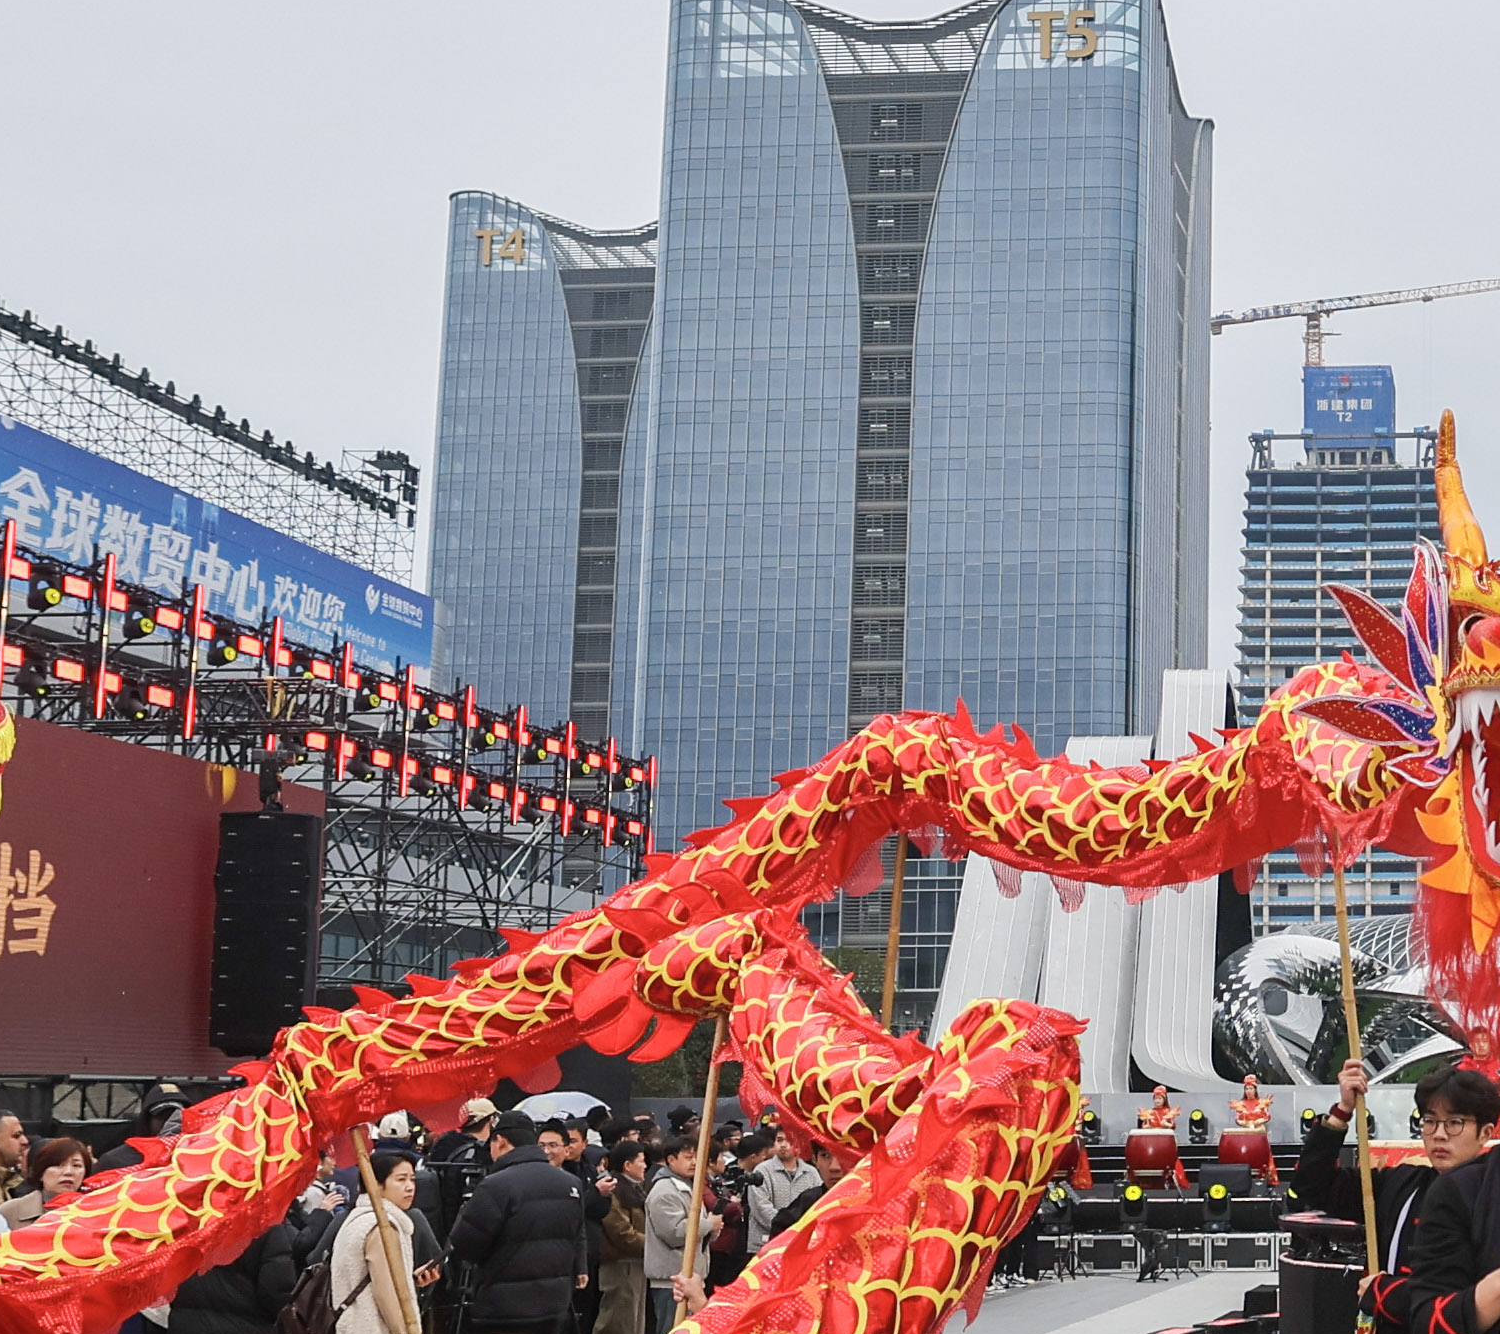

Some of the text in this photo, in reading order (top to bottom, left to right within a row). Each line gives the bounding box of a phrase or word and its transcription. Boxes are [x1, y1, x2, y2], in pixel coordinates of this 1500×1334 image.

[1027, 10, 1098, 60] T5
[475, 228, 526, 267] T4
[1337, 411, 1353, 422] T2
[269, 574, 346, 636] 欢迎您
